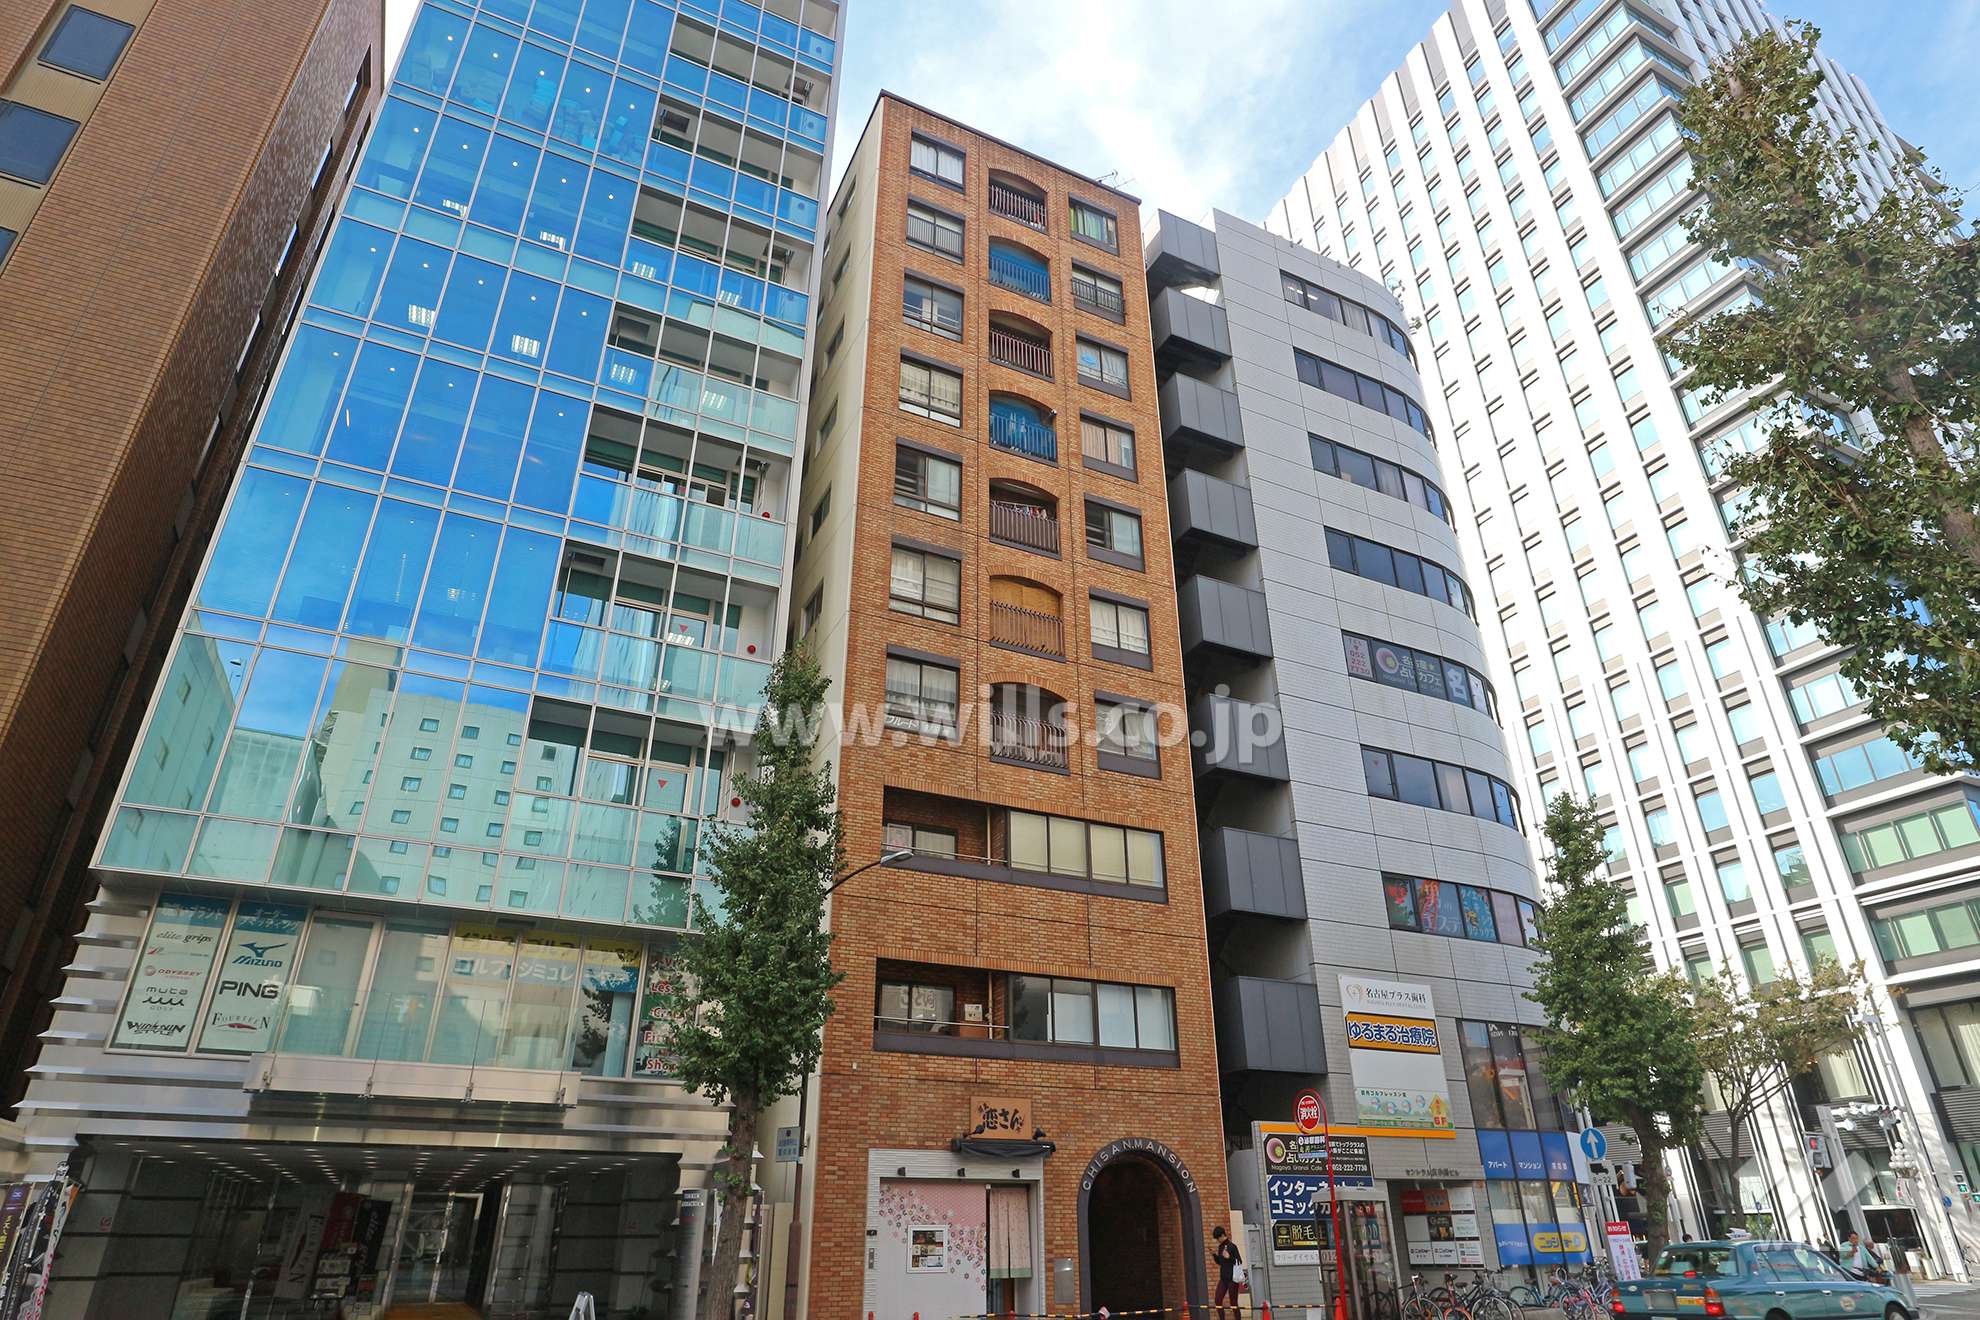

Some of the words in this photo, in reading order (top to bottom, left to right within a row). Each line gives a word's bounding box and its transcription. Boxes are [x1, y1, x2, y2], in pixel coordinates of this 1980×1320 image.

[183, 933, 213, 943] grips
[232, 955, 283, 968] MIZUNO
[219, 980, 279, 999] PING
[1366, 988, 1426, 1003] 名古屋プラス歯科
[1348, 1020, 1438, 1047] ゆるまる治療院
[982, 1108, 1020, 1131] 恋さん
[1300, 1105, 1318, 1120] 消火栓
[1488, 1160, 1508, 1169] アパート
[1518, 1162, 1543, 1170] マンション
